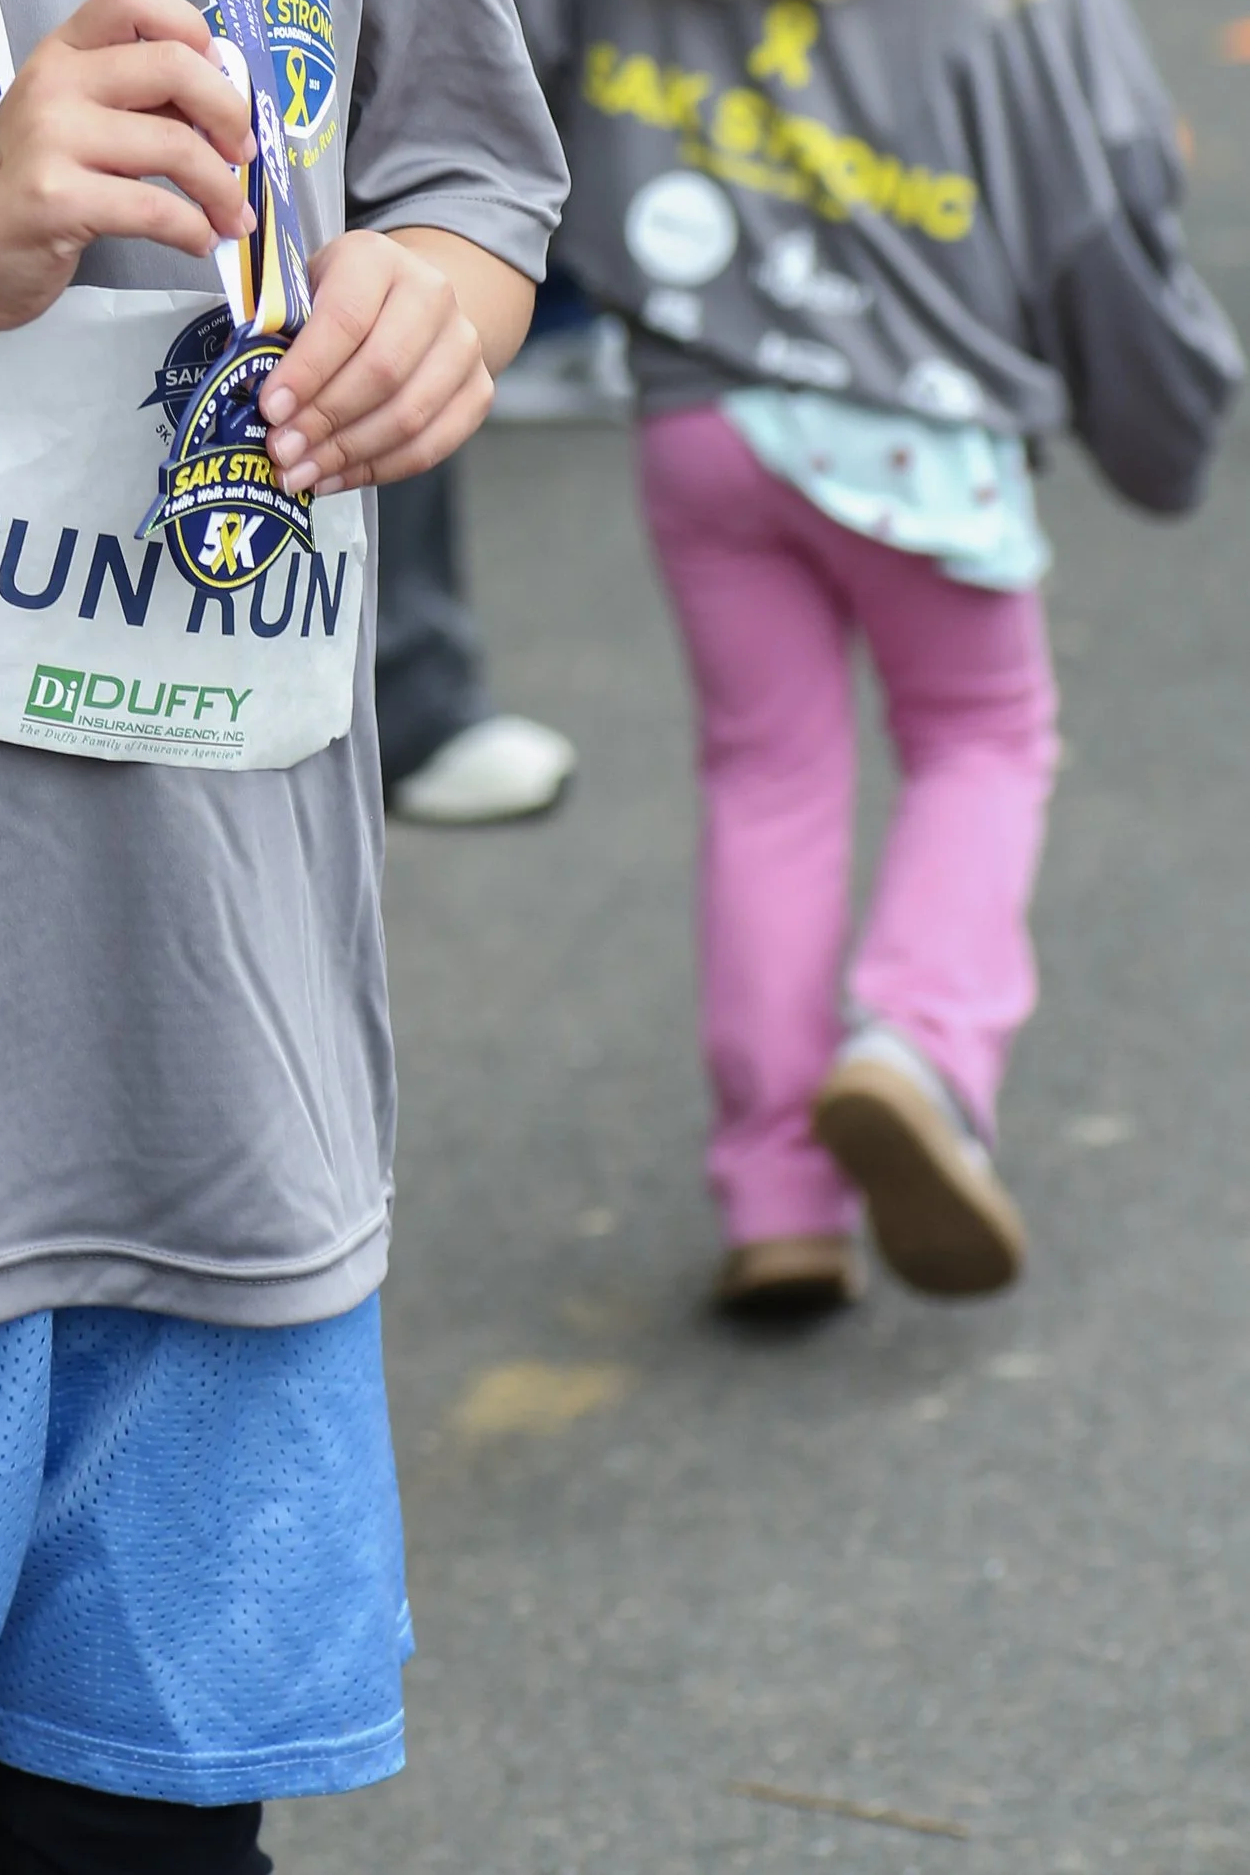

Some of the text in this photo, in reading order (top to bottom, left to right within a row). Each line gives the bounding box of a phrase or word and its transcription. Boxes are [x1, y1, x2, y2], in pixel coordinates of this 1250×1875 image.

[319, 120, 337, 153] Run
[197, 324, 211, 337] NO
[211, 315, 226, 327] ONE
[166, 368, 207, 386] SAK
[199, 398, 217, 429] NO
[220, 363, 248, 396] ONE
[244, 425, 266, 438] 2026
[172, 455, 226, 497] SAK
[164, 485, 309, 530] 1 Mile Walk and Youth Fun Run
[198, 511, 265, 569] 5K
[31, 672, 254, 722] Di DUFFY
[19, 724, 40, 736] The
[44, 728, 77, 744] Duffy
[82, 736, 121, 751] Family
[124, 739, 136, 751] of
[136, 742, 189, 756] Insurance
[78, 715, 163, 736] INSURANCE
[164, 727, 220, 742] AGENCY,
